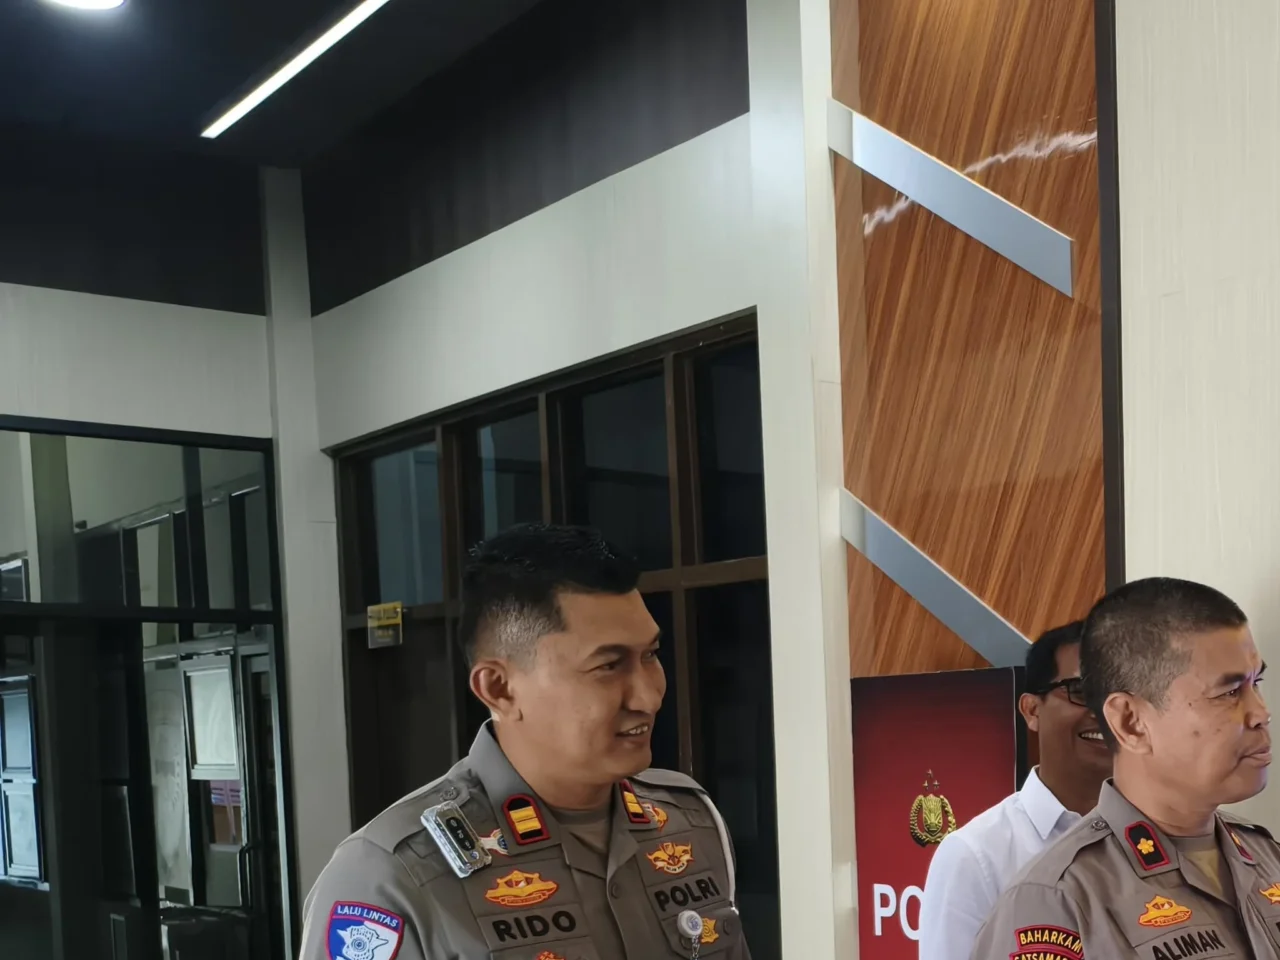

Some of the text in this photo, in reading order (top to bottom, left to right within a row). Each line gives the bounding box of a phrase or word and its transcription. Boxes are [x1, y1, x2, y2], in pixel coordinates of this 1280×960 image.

[654, 876, 720, 912] POLRI
[337, 904, 399, 928] LALU LINTAS
[492, 910, 577, 942] RIDO
[873, 883, 922, 941] PO
[1019, 929, 1083, 953] BAHARKAM
